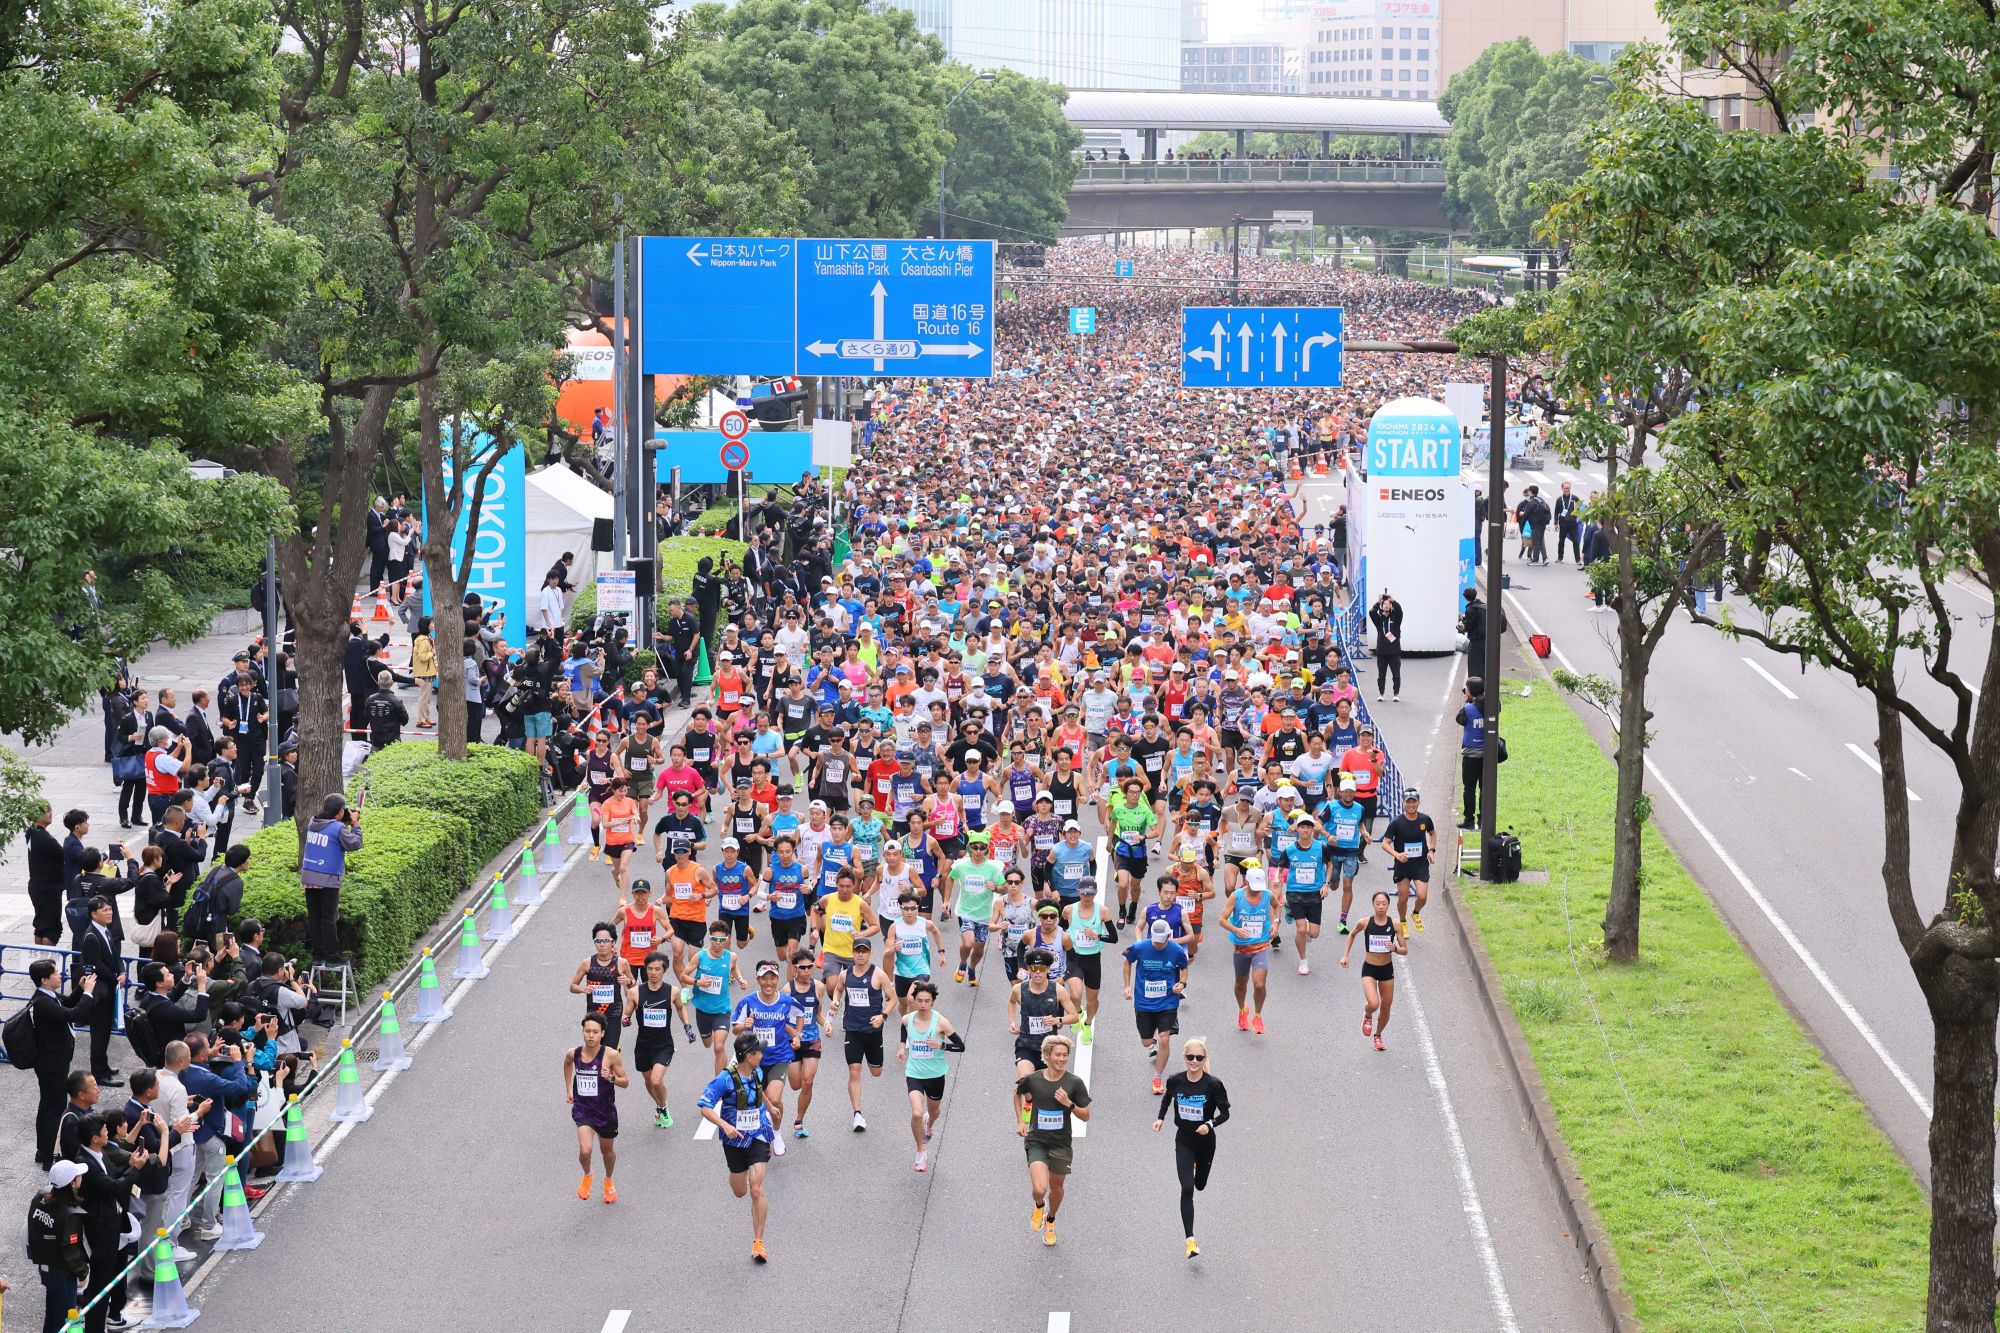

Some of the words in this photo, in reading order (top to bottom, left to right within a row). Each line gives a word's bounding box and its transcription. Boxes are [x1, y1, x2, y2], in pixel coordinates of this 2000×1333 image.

[710, 244, 790, 258] 日本丸パーク
[816, 244, 887, 261] 山下公園
[901, 245, 974, 262] 大さん橋
[710, 259, 758, 268] Nippon-Maru
[760, 259, 777, 268] Park
[814, 262, 866, 276] Yamashita
[868, 262, 890, 276] Park
[901, 262, 952, 277] Osanbashi
[954, 262, 974, 276] Pier
[1120, 265, 1128, 276] F
[913, 304, 986, 321] 国道16号
[1076, 314, 1090, 328] E
[917, 322, 960, 336] Route
[966, 322, 980, 336] 16
[572, 351, 614, 361] NEOS
[847, 343, 912, 356] さくら通り
[726, 418, 742, 432] 50
[1375, 438, 1452, 469] START
[1392, 488, 1445, 501] ENEOS
[465, 448, 506, 622] YOKOHA
[1472, 718, 1484, 728] PH
[306, 831, 328, 847] HOTO
[750, 1008, 785, 1021] YOKOHAMA
